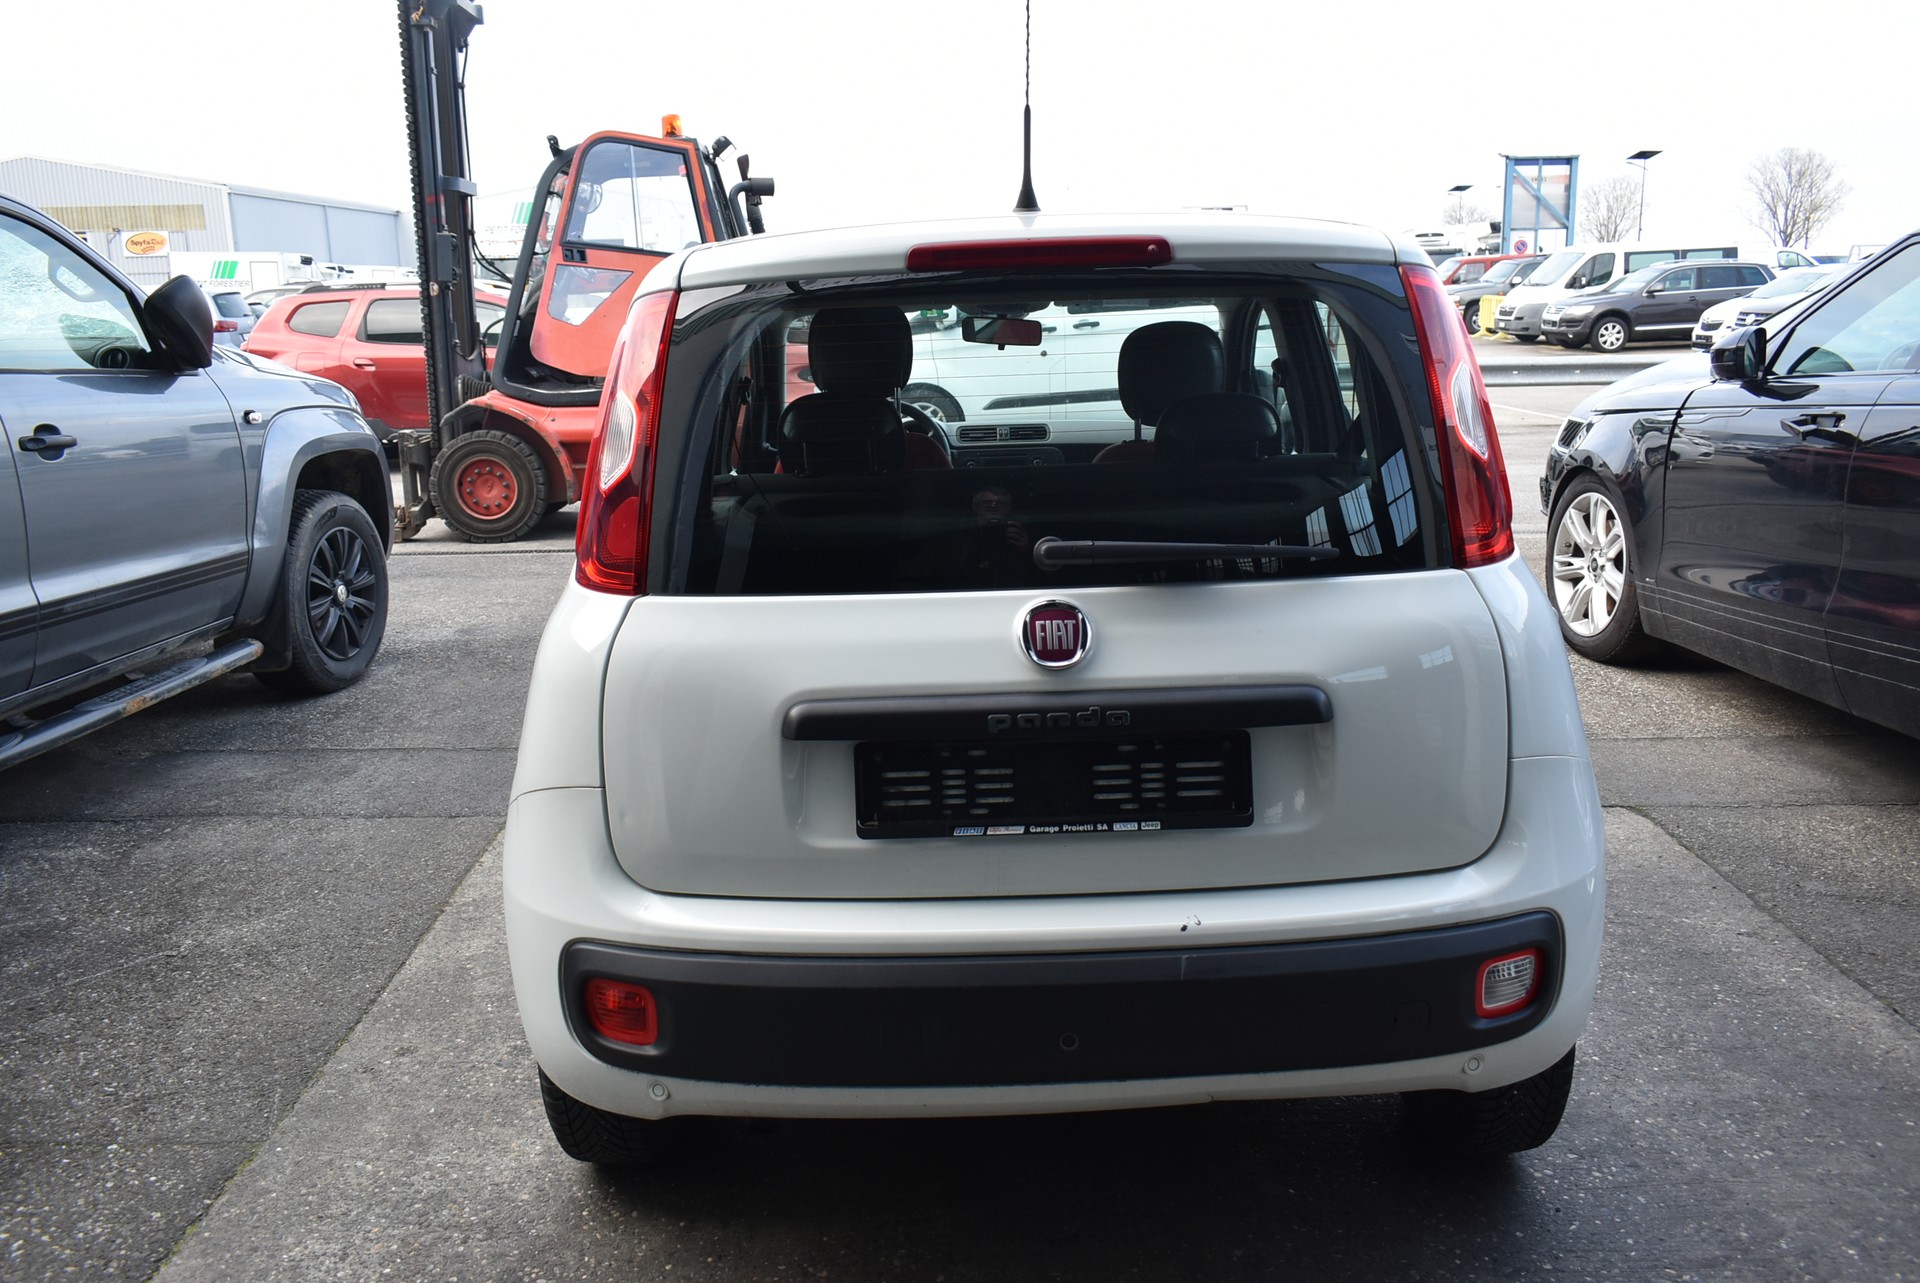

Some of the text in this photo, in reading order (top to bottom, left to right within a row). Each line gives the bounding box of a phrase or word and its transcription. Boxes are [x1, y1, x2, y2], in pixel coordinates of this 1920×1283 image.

[209, 279, 250, 288] FORESTIER
[1035, 620, 1076, 651] FIAT
[987, 706, 1131, 734] panda
[1029, 825, 1060, 834] Garage
[1062, 823, 1094, 832] Proietti
[1096, 823, 1108, 831] SA
